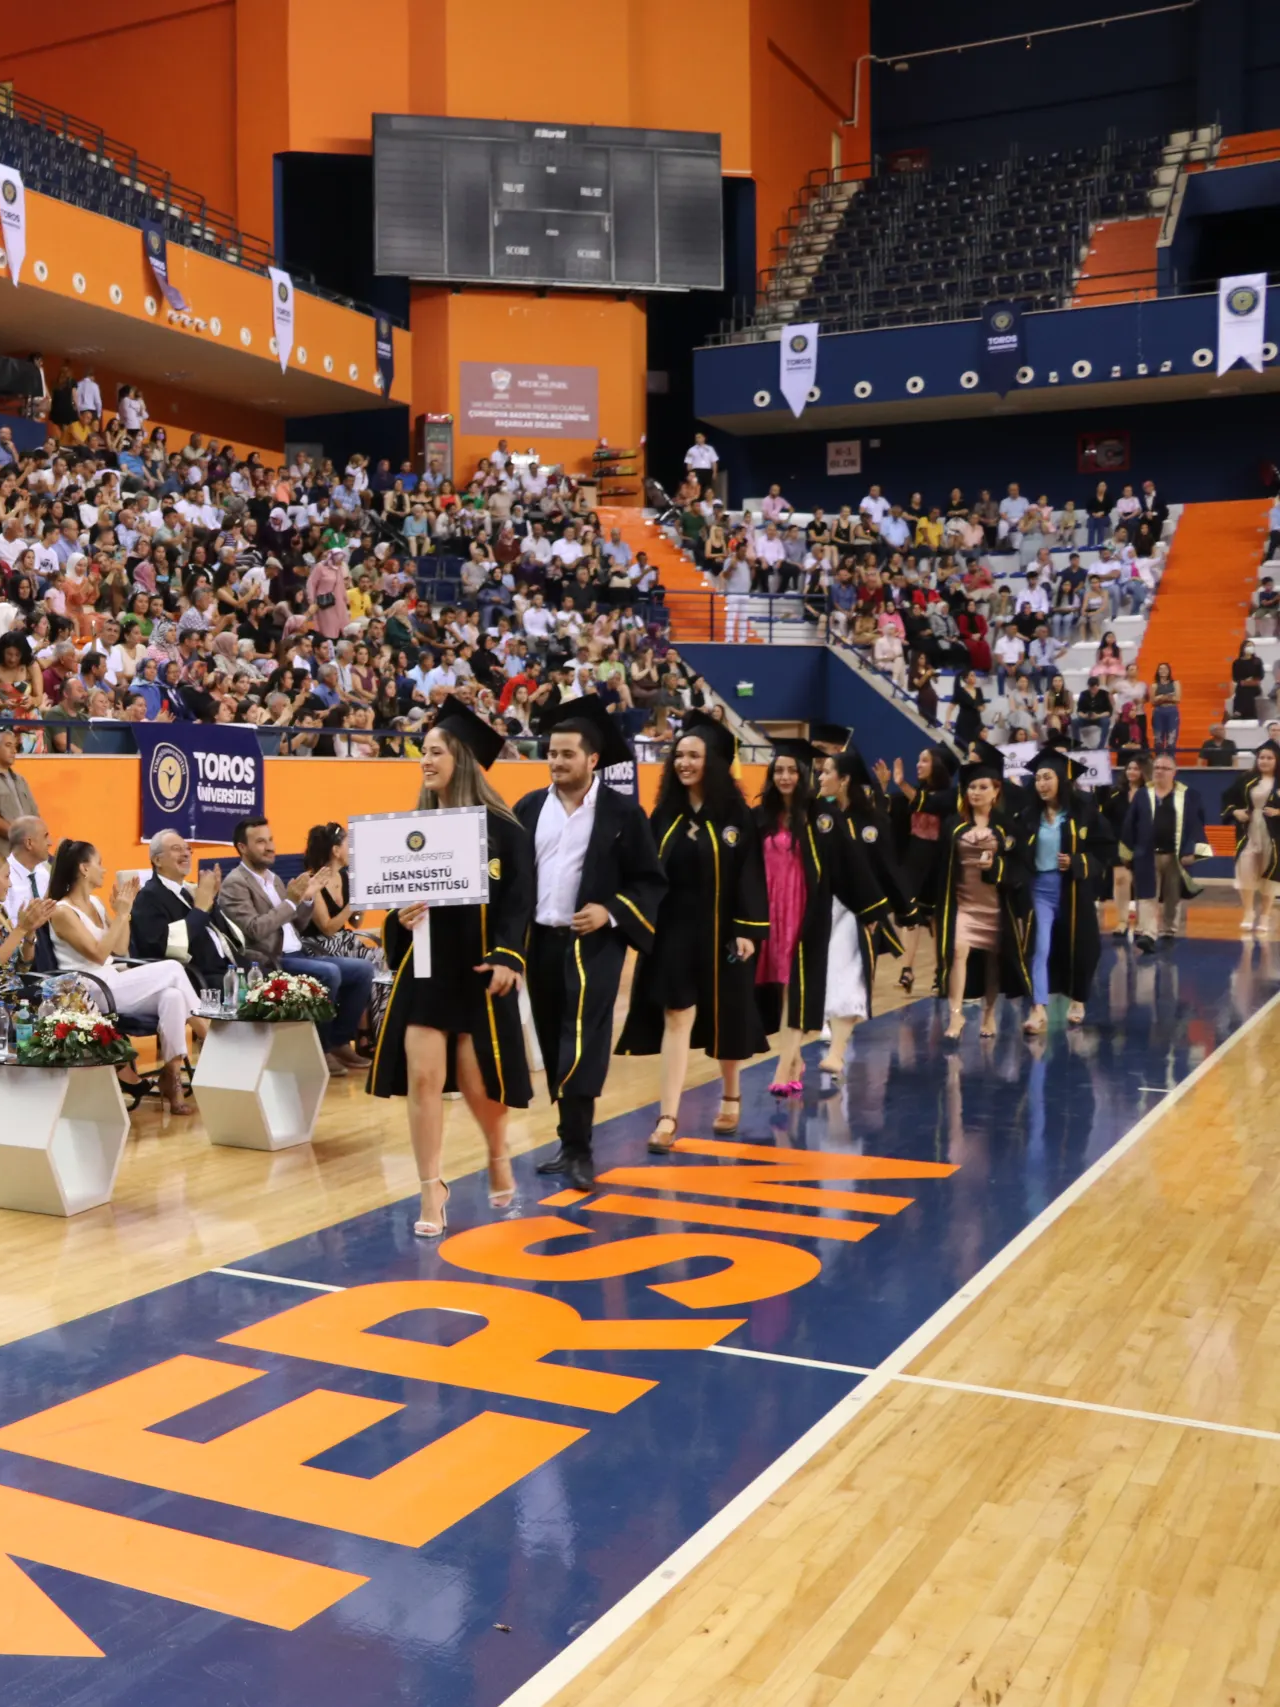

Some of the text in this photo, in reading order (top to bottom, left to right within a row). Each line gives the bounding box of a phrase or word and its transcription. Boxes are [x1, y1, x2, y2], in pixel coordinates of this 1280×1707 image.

[505, 246, 530, 256] SCORE
[577, 249, 601, 259] SCORE
[987, 335, 1018, 345] TOROS
[193, 752, 255, 784] TOROS
[604, 761, 634, 780] TOROS
[197, 782, 255, 805] ÜNİVERSİTESİ
[380, 855, 405, 864] TOROS
[382, 865, 452, 882] LİSANSÜSTÜ
[367, 878, 469, 895] EĞİTİM ENSTİTÜSÜ
